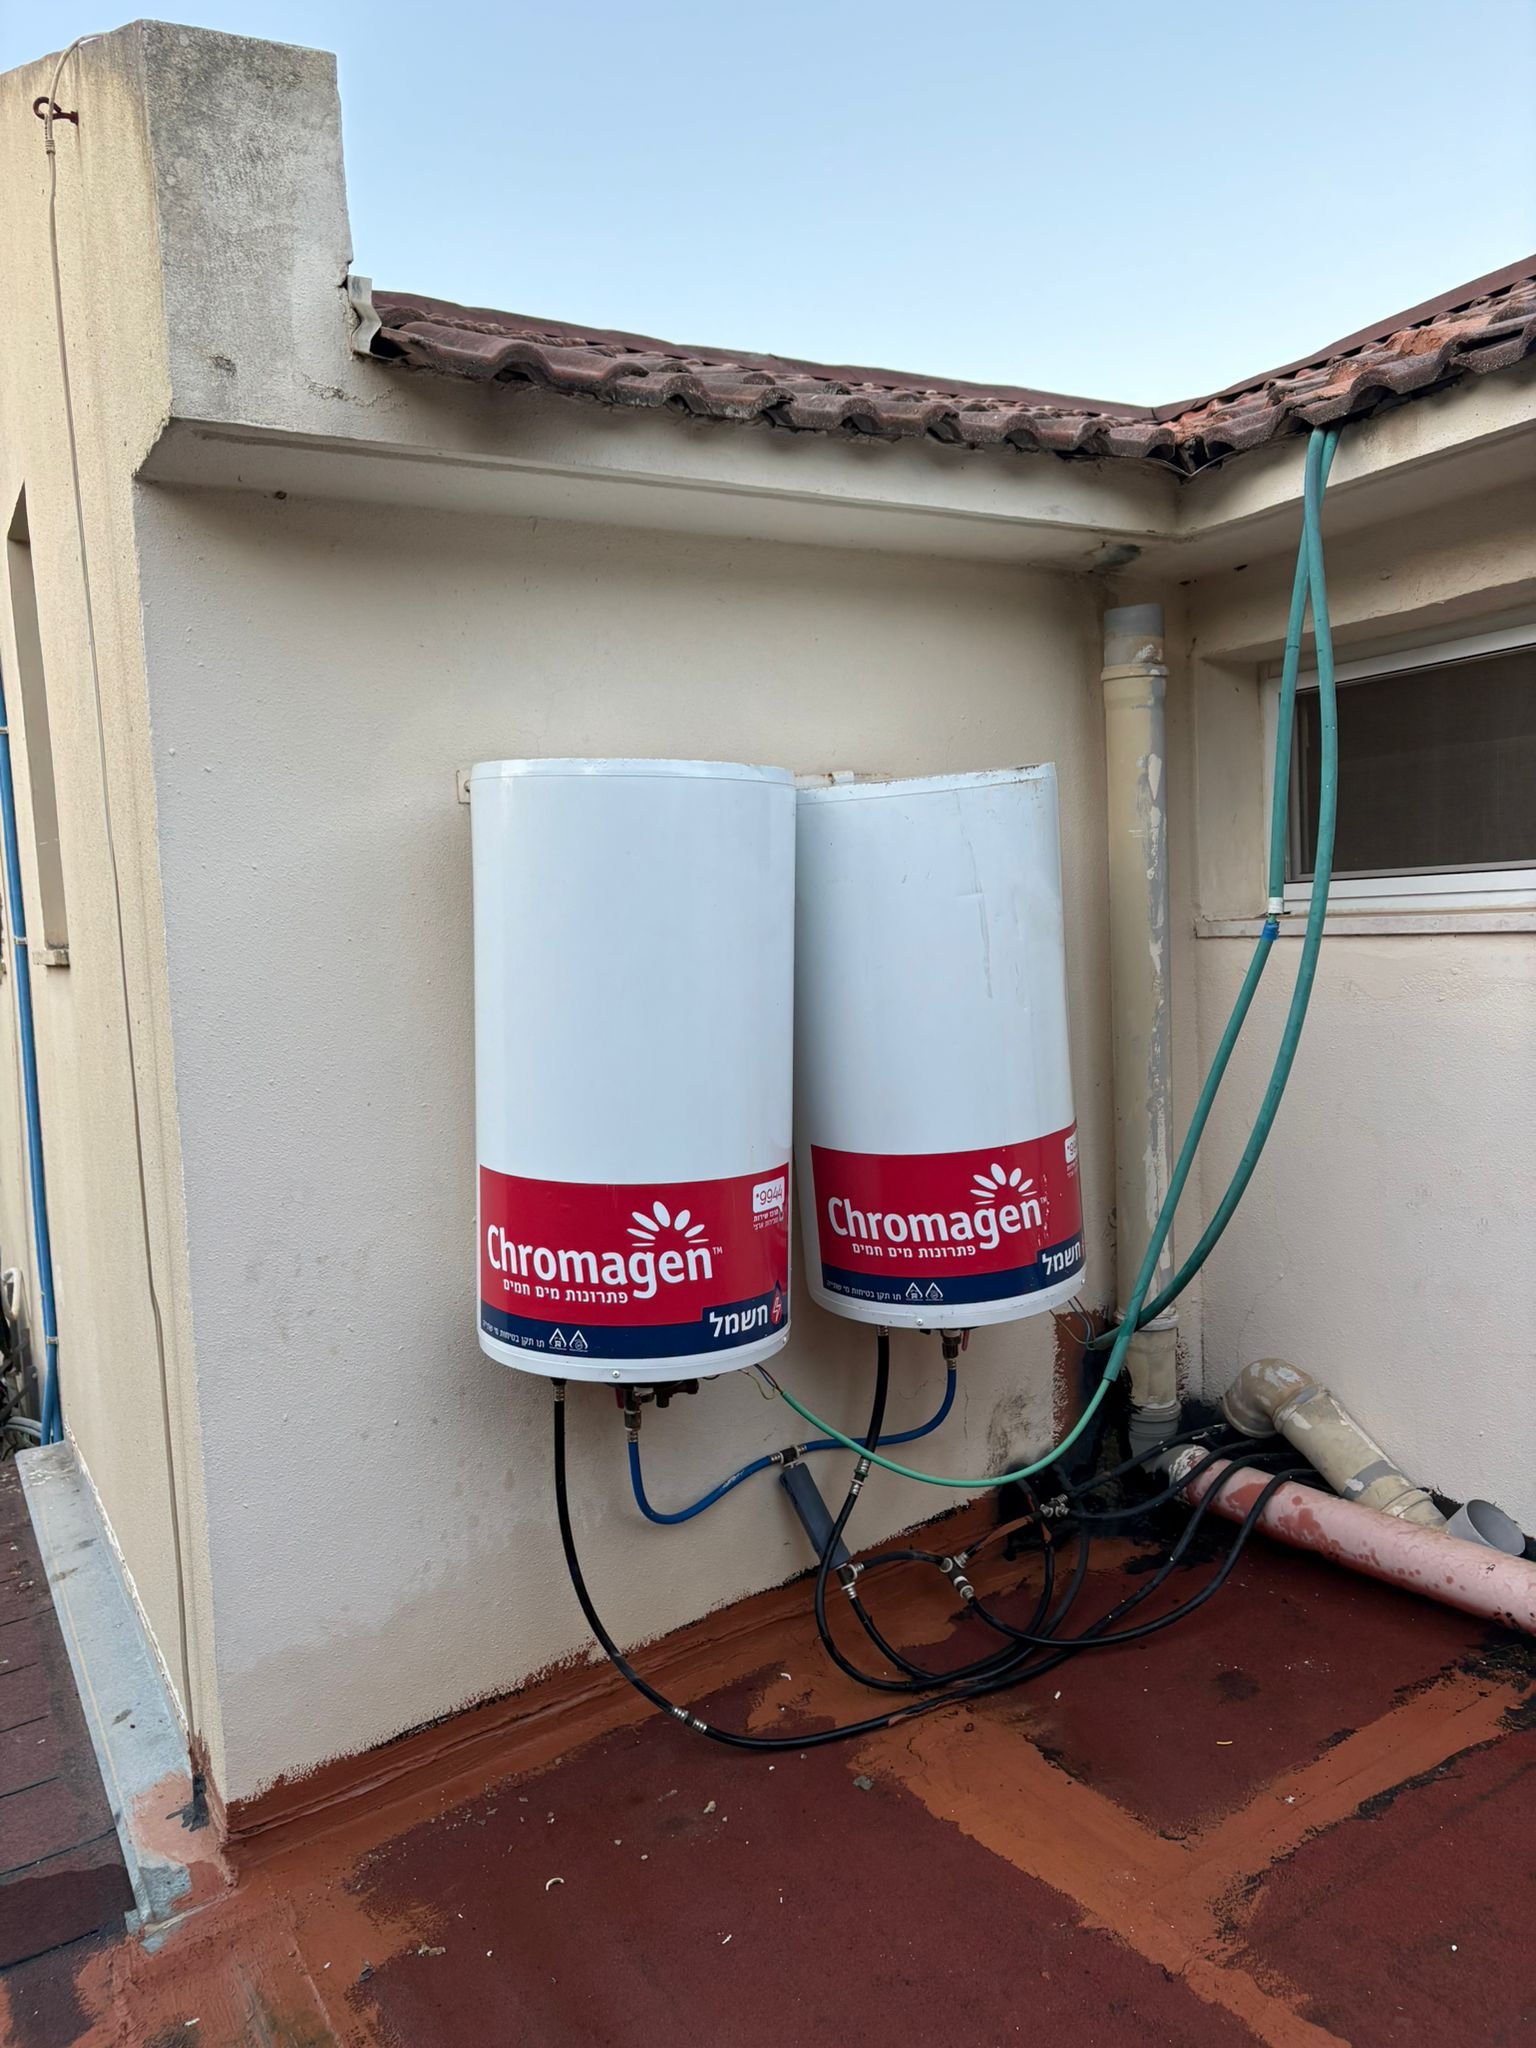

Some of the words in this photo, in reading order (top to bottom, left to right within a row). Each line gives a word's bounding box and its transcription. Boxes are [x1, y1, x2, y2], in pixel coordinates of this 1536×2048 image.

[828, 1196, 1043, 1249] Chromagen
[851, 1242, 884, 1257] חמים
[888, 1247, 913, 1258] מים
[918, 1244, 977, 1259] פתרונות
[487, 1224, 713, 1299] Chromagen
[1041, 1241, 1082, 1276] חשמל
[502, 1277, 532, 1296] חמים
[535, 1286, 561, 1300] מים
[564, 1288, 629, 1304] פתרונות
[709, 1304, 768, 1338] חשמל
